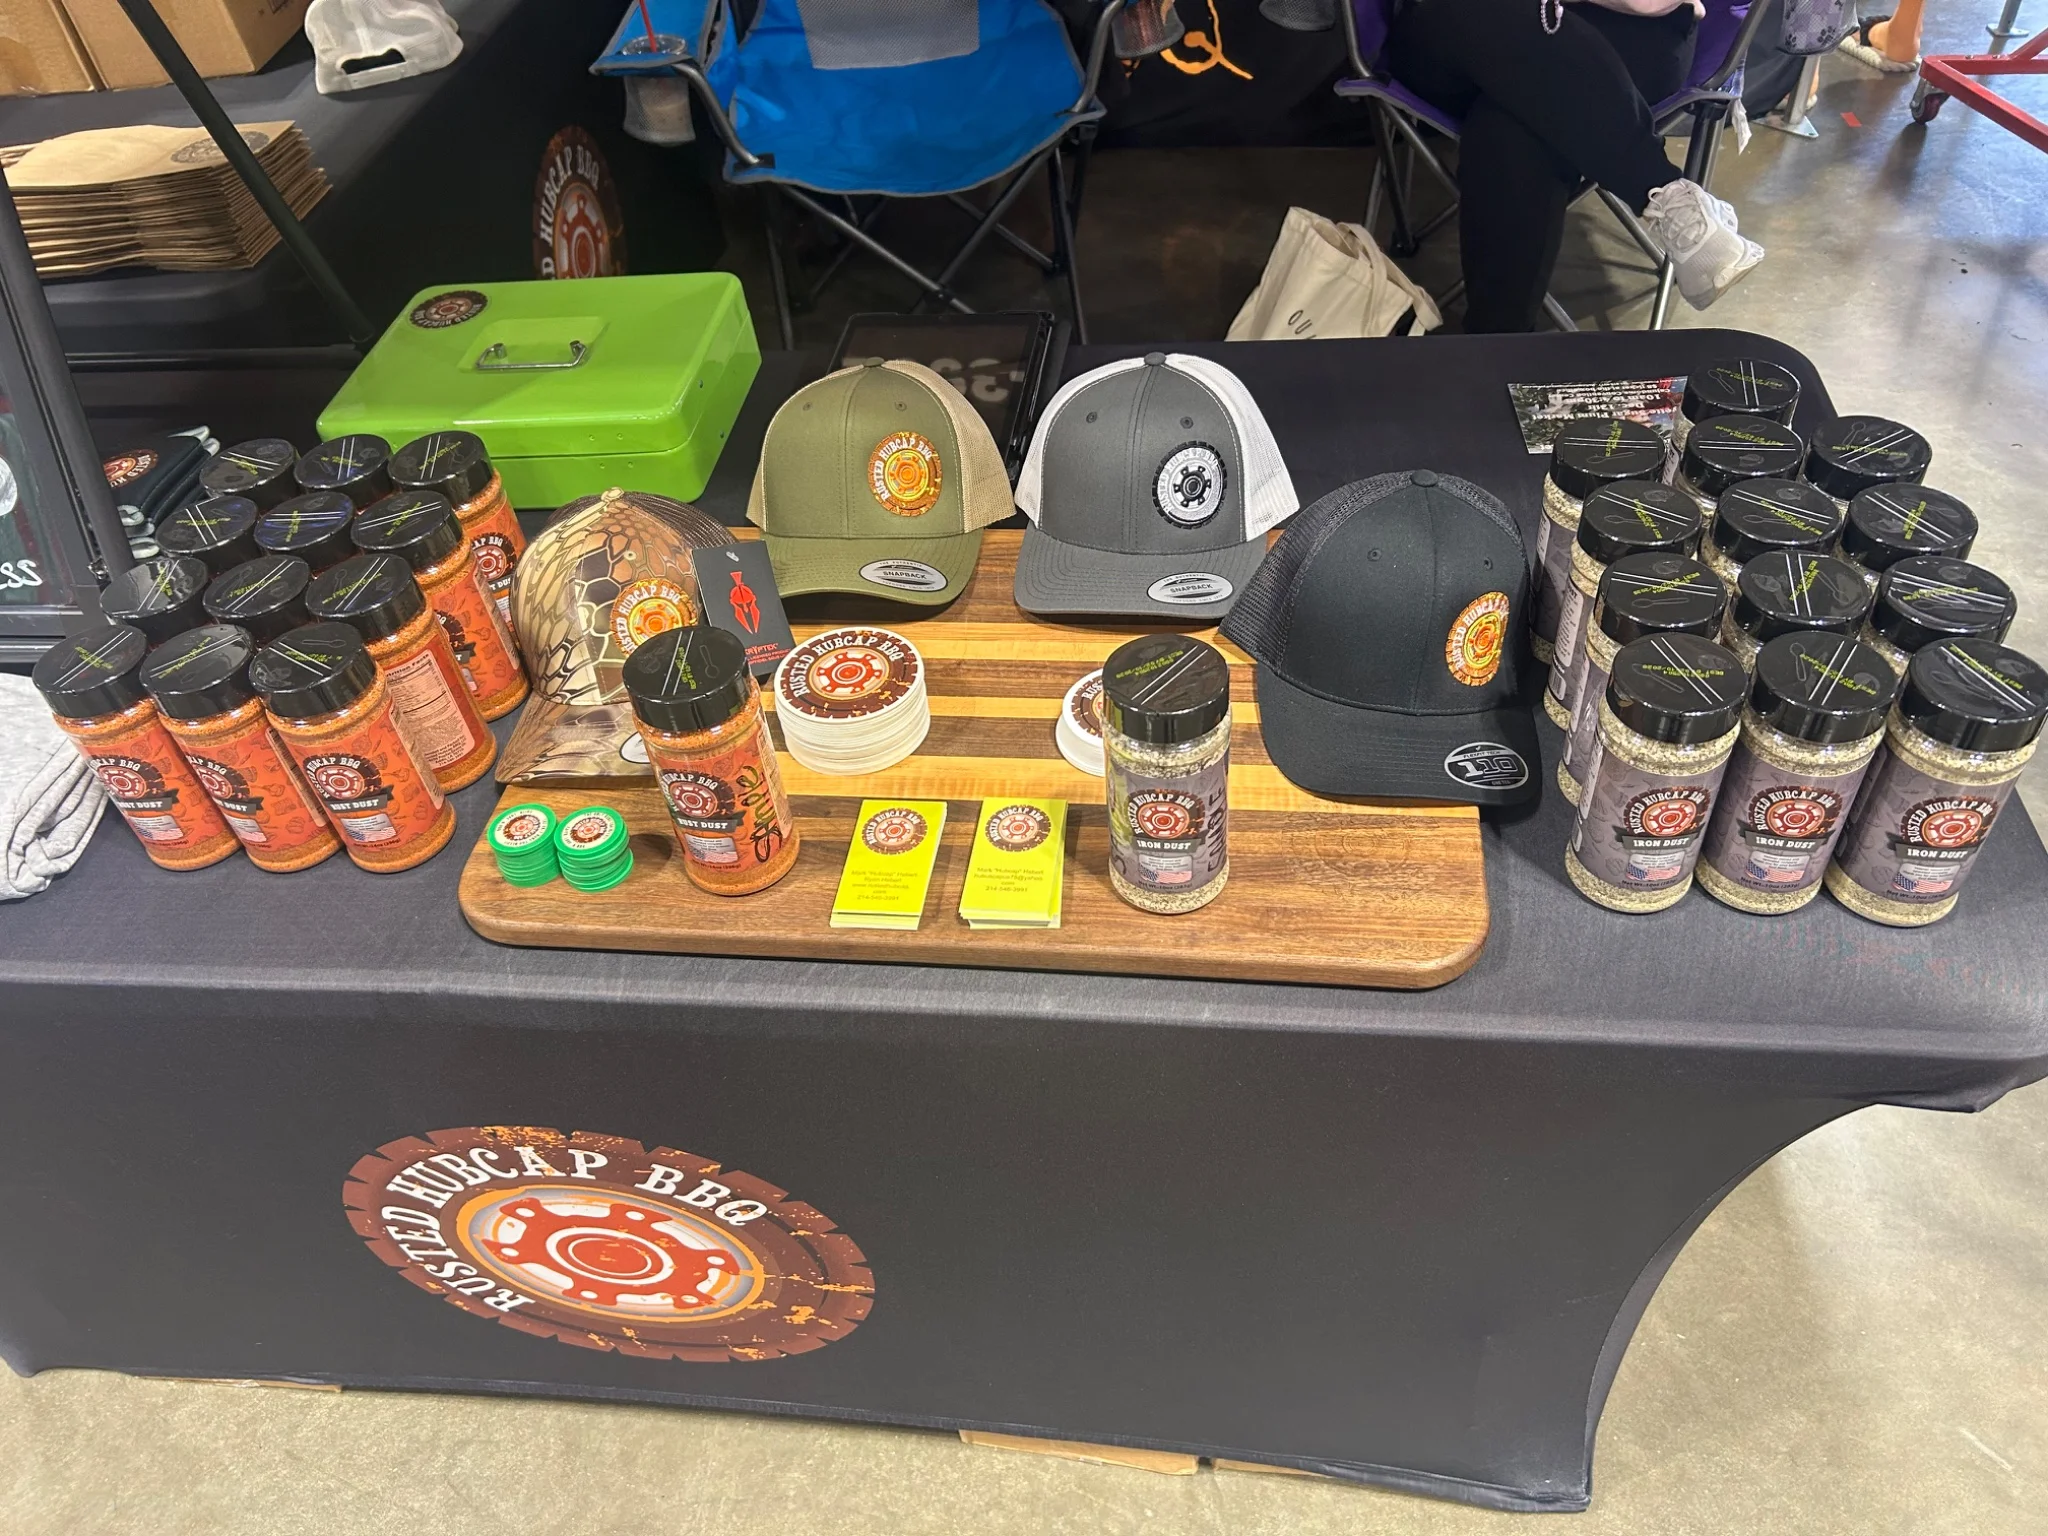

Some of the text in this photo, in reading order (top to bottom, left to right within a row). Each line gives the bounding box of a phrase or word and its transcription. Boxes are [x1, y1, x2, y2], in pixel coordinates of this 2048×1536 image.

[540, 144, 599, 247] HUBCAP BBQ
[873, 437, 934, 502] RUSTED HUBCAP BBQ
[883, 570, 927, 580] SNAPBACK
[1170, 583, 1213, 594] SNAPBACK
[618, 585, 657, 614] HUBCAP
[660, 586, 681, 603] BBQ
[1452, 628, 1467, 671] RUSTED
[789, 636, 905, 698] RUSTED HUBCAP BBQ
[119, 759, 141, 772] BBQ
[207, 761, 228, 776] BBQ
[340, 756, 361, 770] BBQ
[1457, 756, 1518, 778] 110
[697, 776, 719, 790] BBQ
[138, 800, 163, 809] DUST
[353, 799, 379, 810] DUST
[1754, 790, 1836, 831] RUSTED HUBCAP BBQ
[999, 807, 1030, 820] HUBCAP
[1127, 793, 1195, 835] RUSTED HUBCAP BBQ
[1629, 790, 1706, 834] RUSTED HUBCAP BBQ
[677, 818, 698, 828] RUST
[865, 821, 878, 845] RUSTED
[875, 810, 906, 823] HUBCAP
[1907, 800, 1993, 843] RUSTED HUBCAP BBQ
[1136, 839, 1191, 850] IRON DUST
[1633, 838, 1689, 847] IRON DUST
[1755, 836, 1816, 849] IRON DUST
[1907, 848, 1968, 859] IRON DUST
[381, 1145, 769, 1313] RUSTED HUBCAP BBQ
